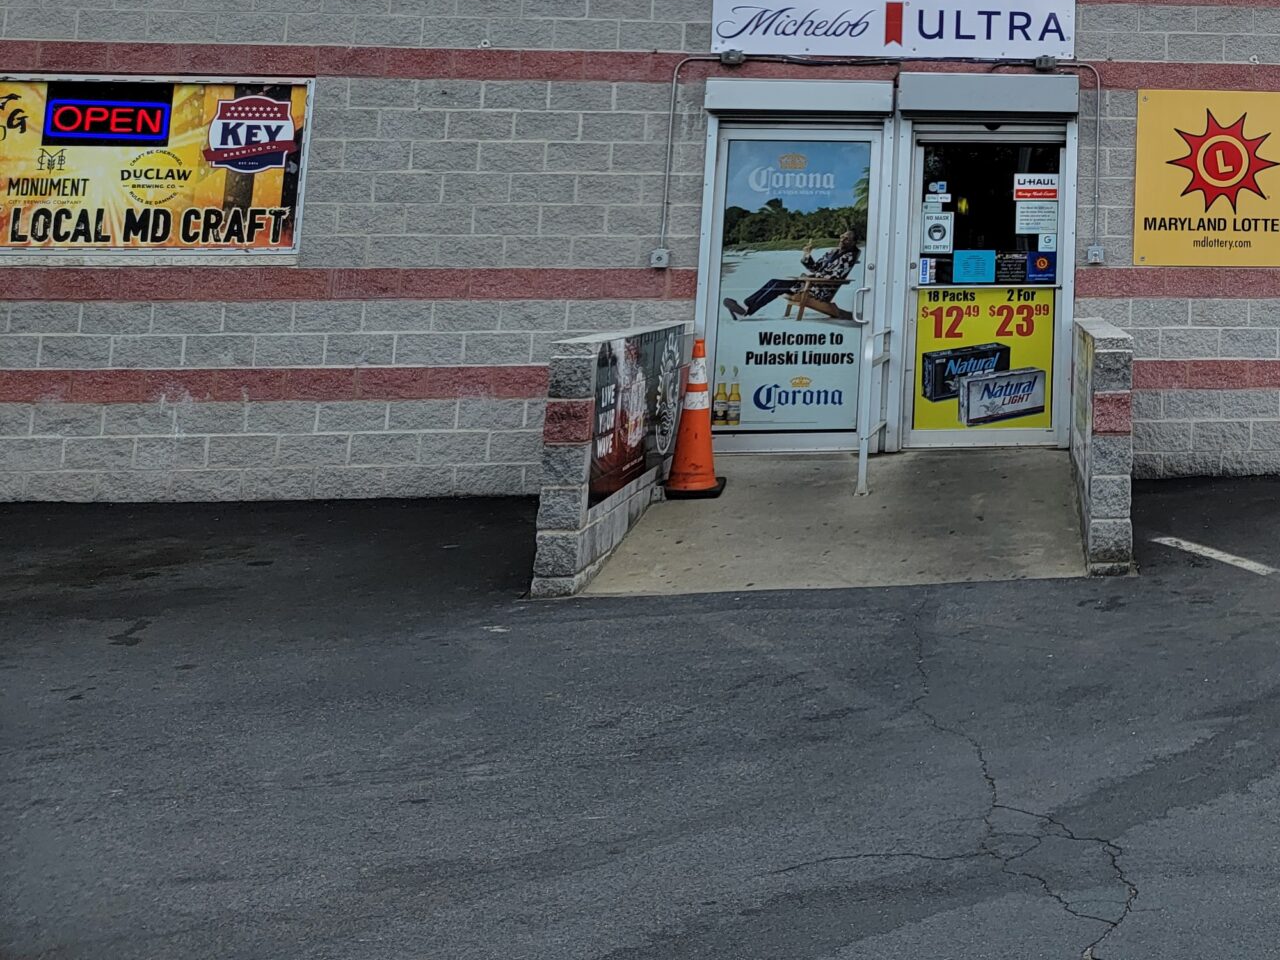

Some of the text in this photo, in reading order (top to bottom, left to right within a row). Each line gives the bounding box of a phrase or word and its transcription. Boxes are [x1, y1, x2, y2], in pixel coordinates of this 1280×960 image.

[716, 5, 1066, 41] Michelob ULTRA
[52, 105, 162, 133] OPEN
[220, 122, 285, 146] KEY
[7, 178, 90, 197] MONUMENT
[749, 167, 835, 192] Corona
[10, 207, 291, 243] LOCAL MD CRAFT
[1143, 217, 1227, 231] MARYLAND
[1192, 236, 1252, 250] mdlottery.com
[928, 291, 976, 302] 18 Packs
[1007, 290, 1036, 302] 2 For
[759, 332, 844, 346] Welcome to
[745, 351, 854, 367] Pulaski Liquors
[944, 352, 1000, 377] Natural
[753, 384, 843, 413] Corona
[980, 375, 1038, 401] Natural
[1002, 393, 1032, 406] LIGHT
